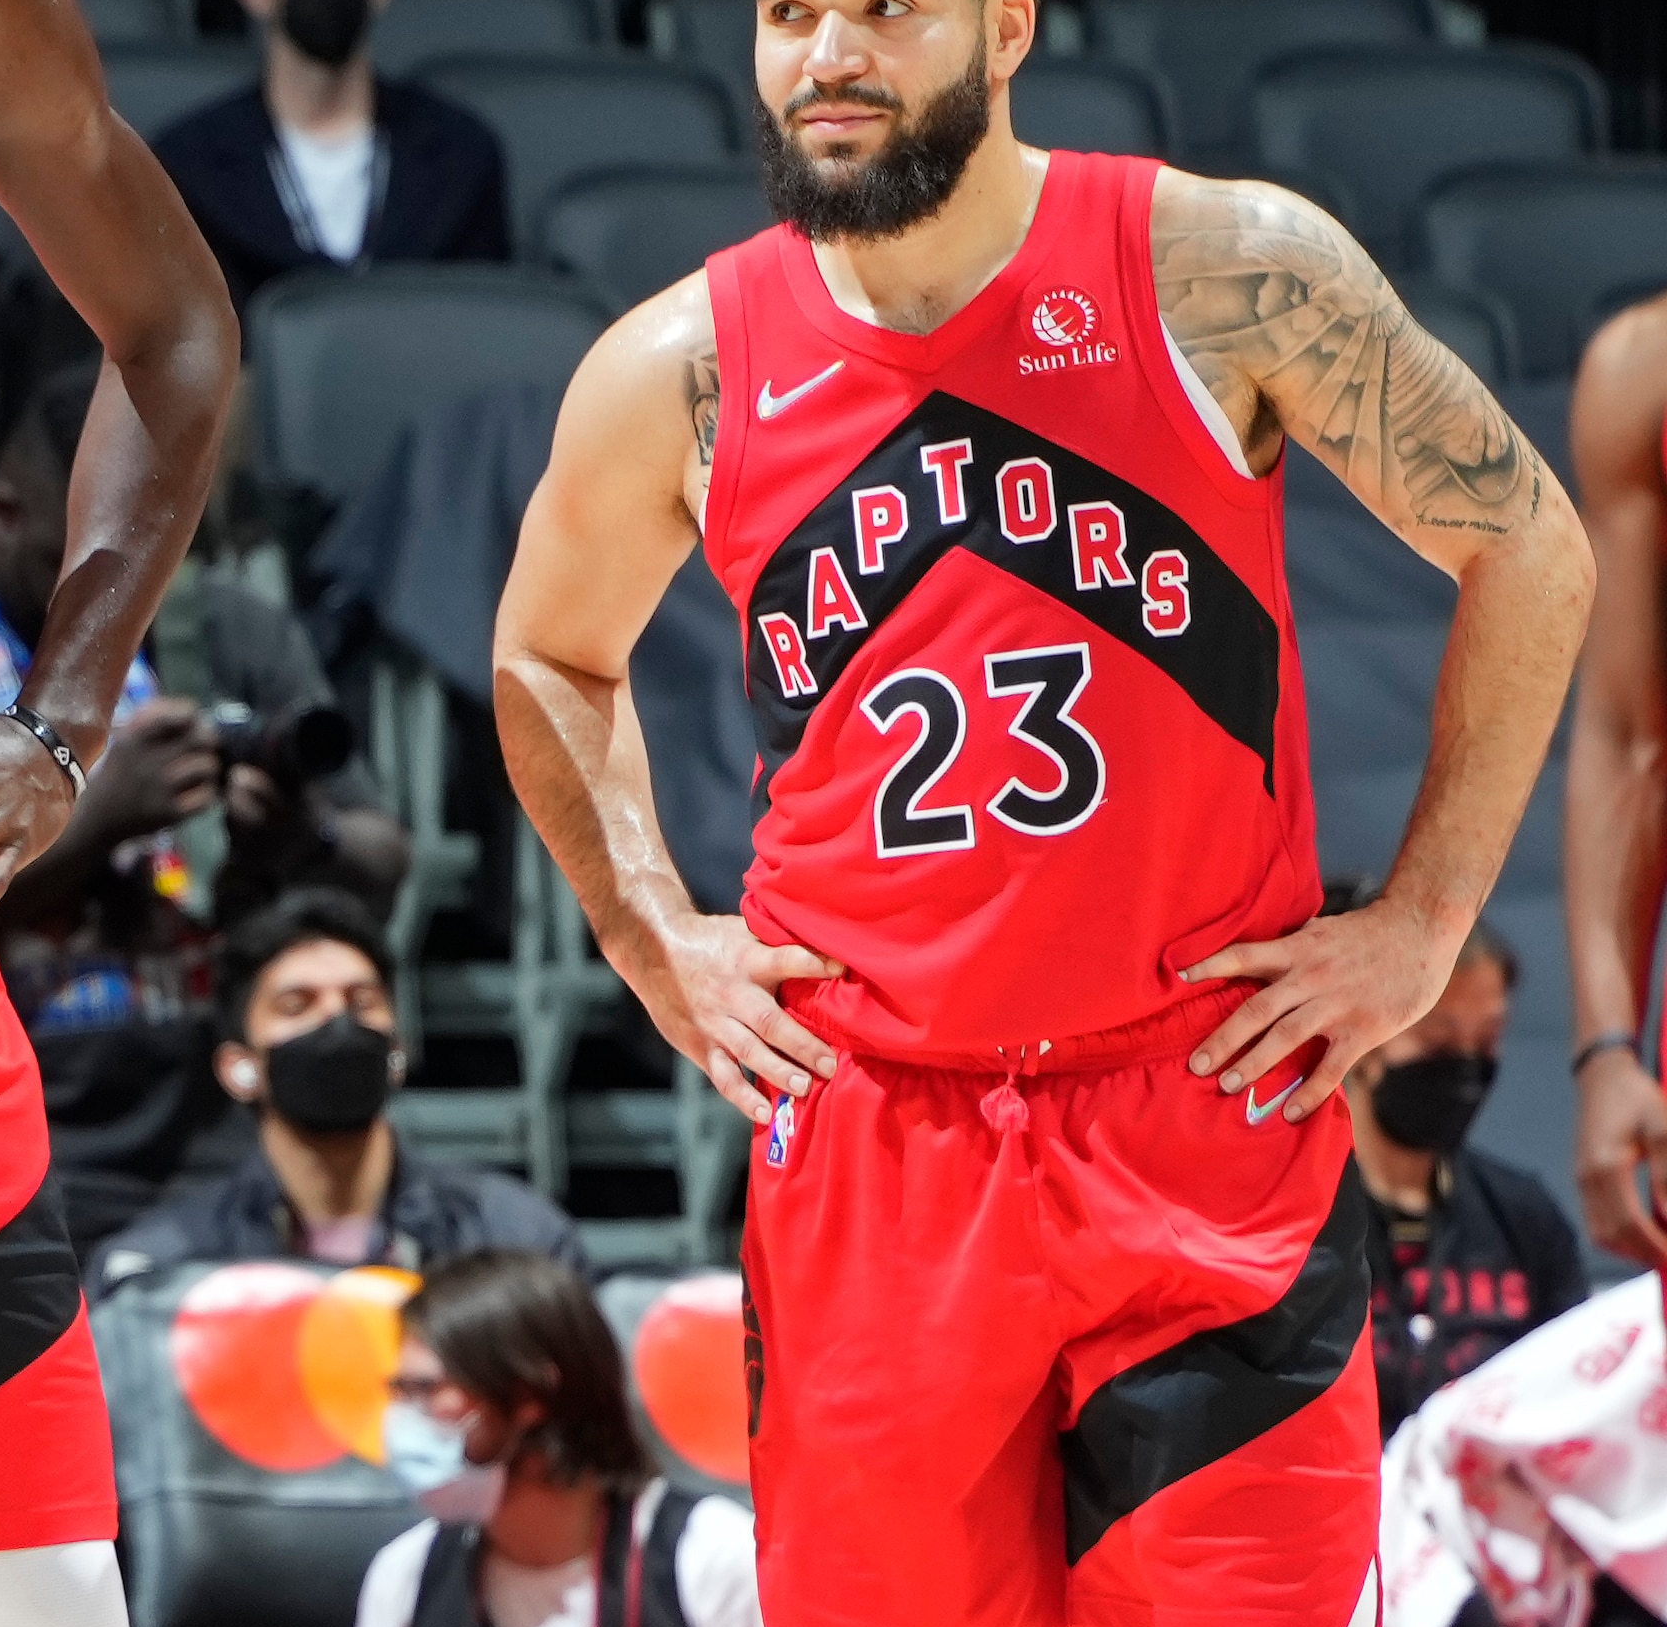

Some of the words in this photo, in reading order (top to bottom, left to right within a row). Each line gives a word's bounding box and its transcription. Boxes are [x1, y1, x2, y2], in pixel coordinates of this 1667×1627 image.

[1018, 354, 1066, 375] Sun
[1071, 341, 1116, 365] Life
[758, 437, 1190, 698] RAPTORS
[859, 642, 1106, 858] 23
